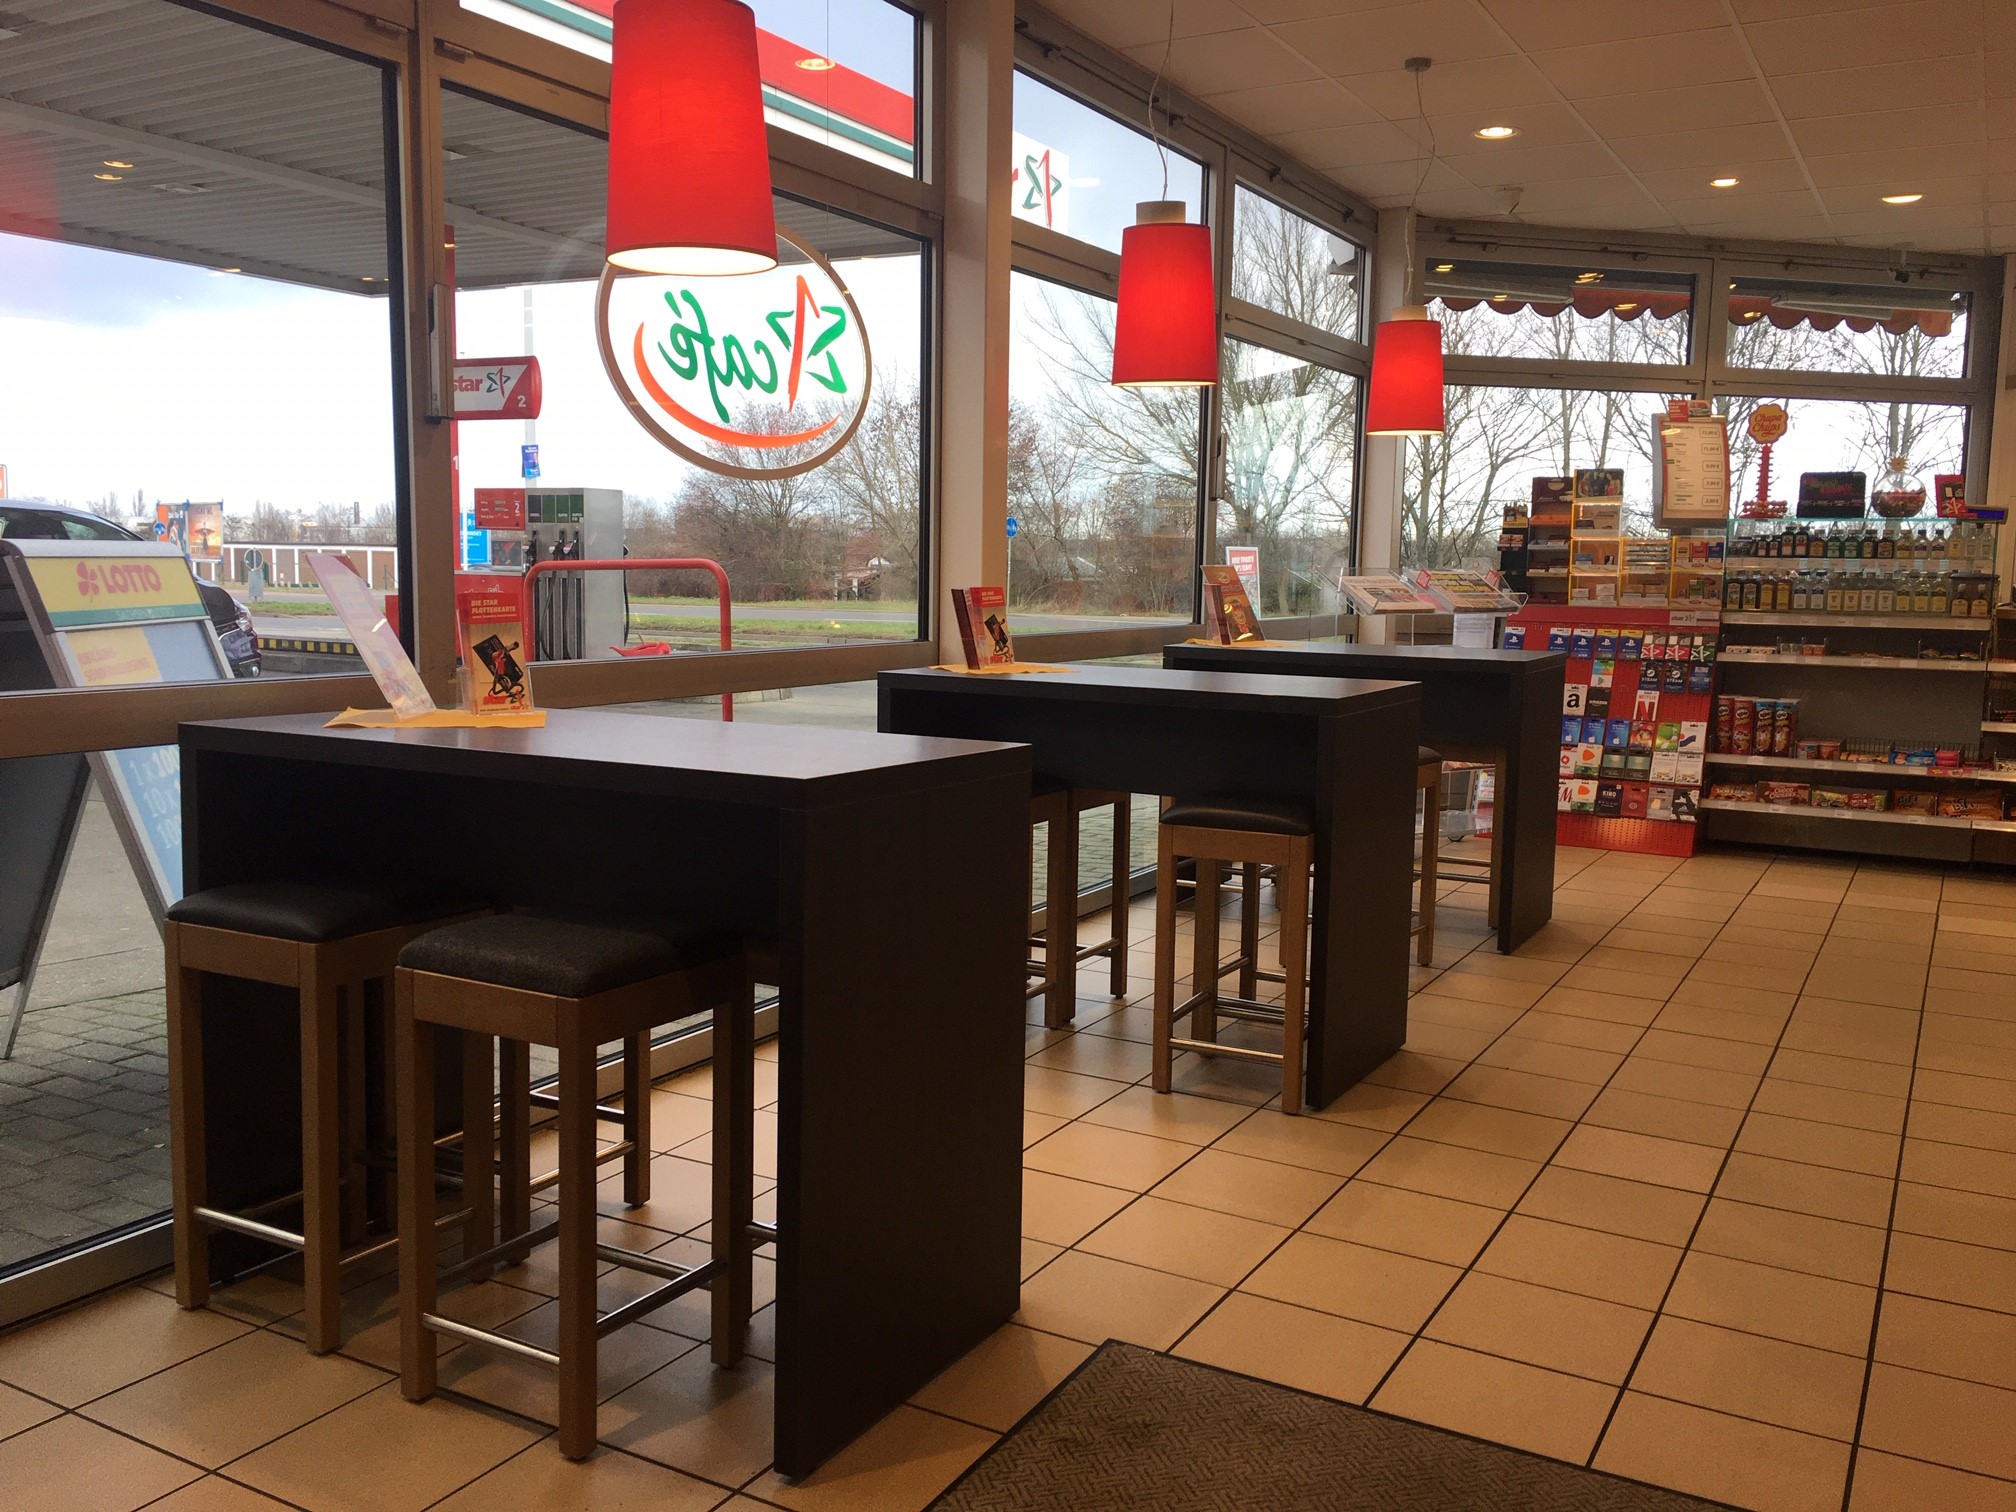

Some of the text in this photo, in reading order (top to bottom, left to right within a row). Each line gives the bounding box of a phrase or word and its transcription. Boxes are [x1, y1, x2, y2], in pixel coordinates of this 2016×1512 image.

[453, 376, 483, 392] star
[517, 395, 527, 408] 2
[1754, 413, 1783, 424] Chupa
[1751, 422, 1781, 437] Chups
[514, 502, 520, 514] 2
[99, 564, 162, 594] LOTTO
